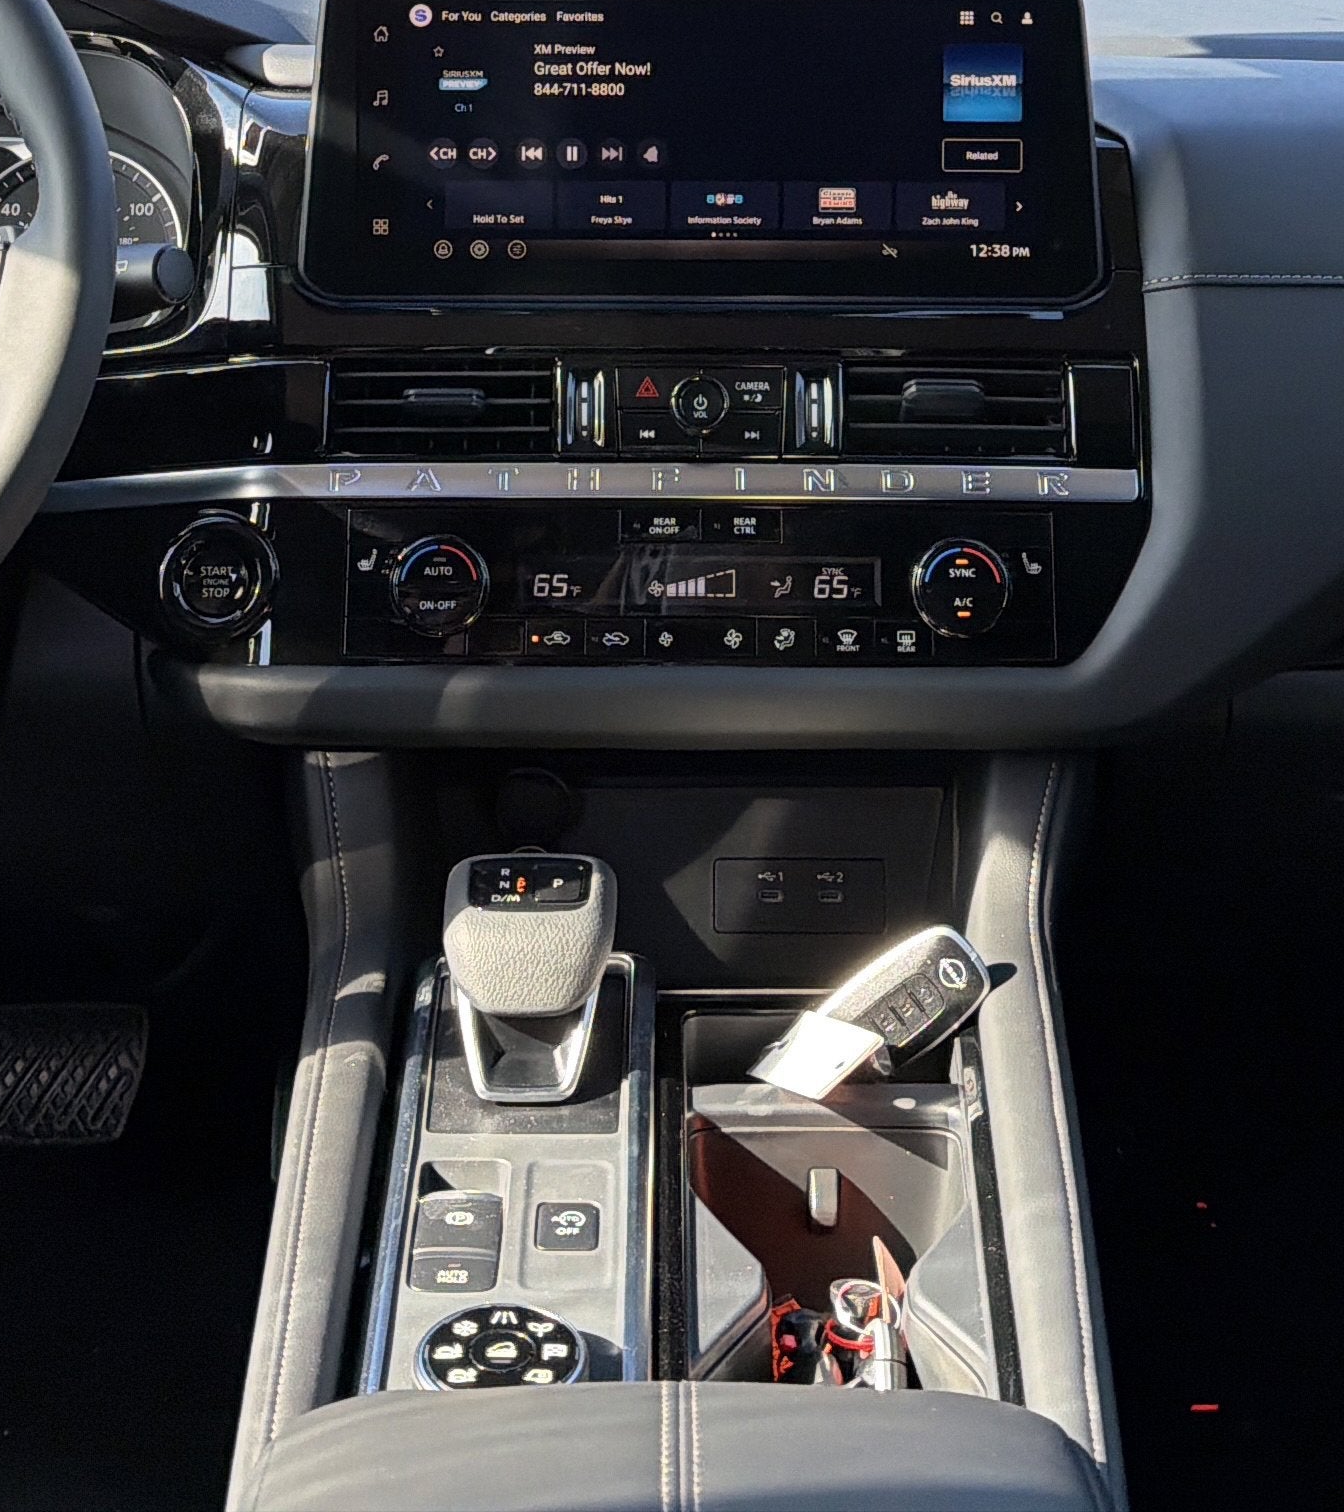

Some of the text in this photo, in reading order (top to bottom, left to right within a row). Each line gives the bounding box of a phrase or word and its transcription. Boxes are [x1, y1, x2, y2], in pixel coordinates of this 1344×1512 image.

[442, 11, 482, 21] For You
[490, 11, 546, 24] Categories
[556, 11, 604, 22] Favorites
[534, 44, 596, 55] XM Preview
[534, 62, 651, 76] Great Offer Now!
[950, 74, 1016, 86] SiriusXM
[534, 84, 624, 96] 844-711-8800
[454, 103, 468, 112] Ch
[966, 151, 998, 160] Related
[600, 194, 616, 204] Hits
[931, 194, 969, 210] highway
[1, 202, 21, 218] 40
[129, 203, 154, 216] 100
[473, 214, 524, 224] Hold To Set
[591, 215, 632, 225] Freya Skye
[688, 216, 762, 226] Information Society
[813, 216, 863, 226] Bryan Adams
[921, 216, 978, 227] Zach John King
[119, 237, 133, 245] 180
[970, 244, 1030, 257] 12:38 PM
[735, 382, 770, 391] CAMERA
[653, 517, 676, 527] REAR
[733, 517, 756, 527] REAR
[733, 526, 756, 535] CTRL
[200, 566, 234, 576] START
[424, 565, 453, 576] AUTO
[948, 568, 976, 578] SYNC
[201, 588, 230, 598] STOP
[954, 598, 973, 608] A/C
[501, 868, 510, 876] R
[836, 872, 844, 882] 2
[499, 881, 510, 889] N
[552, 878, 564, 888] P
[491, 894, 521, 902] D/M
[555, 1227, 580, 1236] OFF
[436, 1276, 468, 1284] HOLD
